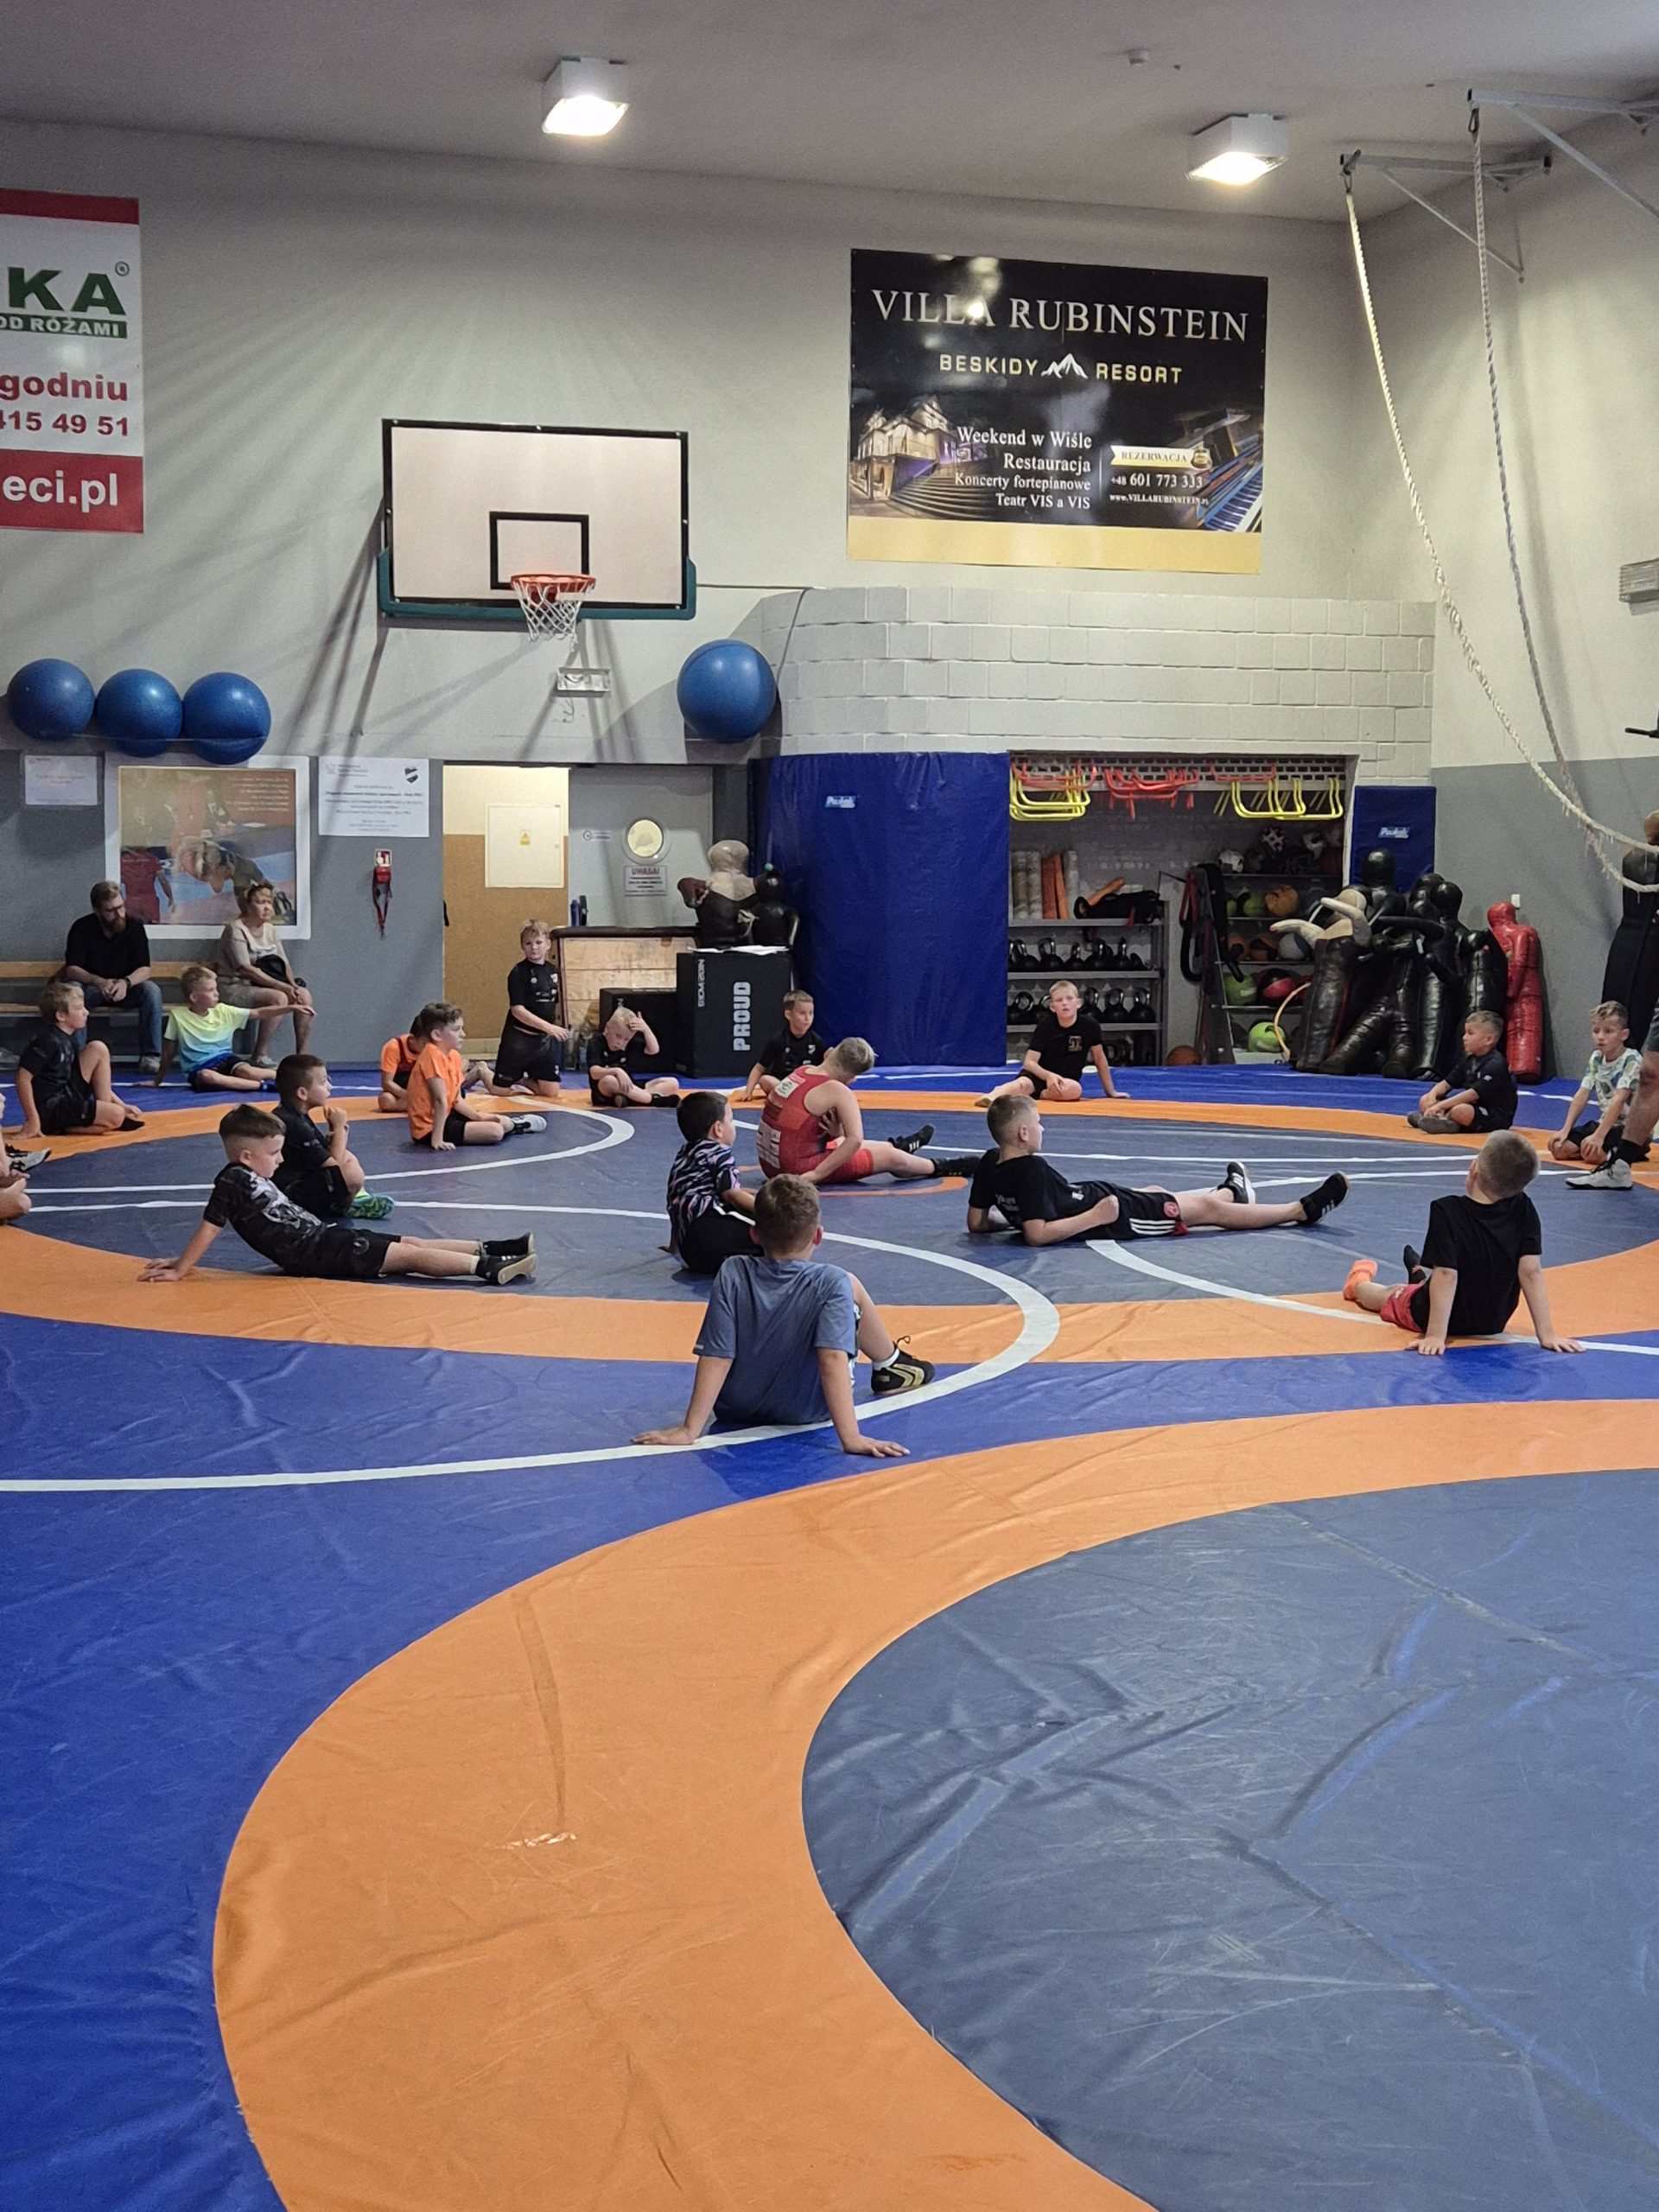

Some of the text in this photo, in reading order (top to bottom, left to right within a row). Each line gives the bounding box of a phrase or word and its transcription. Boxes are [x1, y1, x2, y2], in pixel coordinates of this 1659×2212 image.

[872, 289, 1249, 343] VILLA RUBINSTEIN
[939, 353, 1183, 384] BESKIDY RESORT
[0, 372, 128, 402] godniu
[52, 413, 87, 435] 49
[97, 416, 128, 437] 51
[957, 426, 1093, 449] Weekend w Wiśle
[1003, 452, 1091, 476] Restauracja
[1121, 450, 1188, 464] REZERWACJA
[2, 469, 118, 513] eci.pl
[955, 472, 1091, 493] Koncerty fortepianowe
[1129, 473, 1151, 487] 601
[1155, 474, 1178, 488] 773
[1180, 474, 1204, 489] 333
[995, 493, 1090, 509] Teatr VIS a VIS
[733, 982, 751, 1052] PROUD
